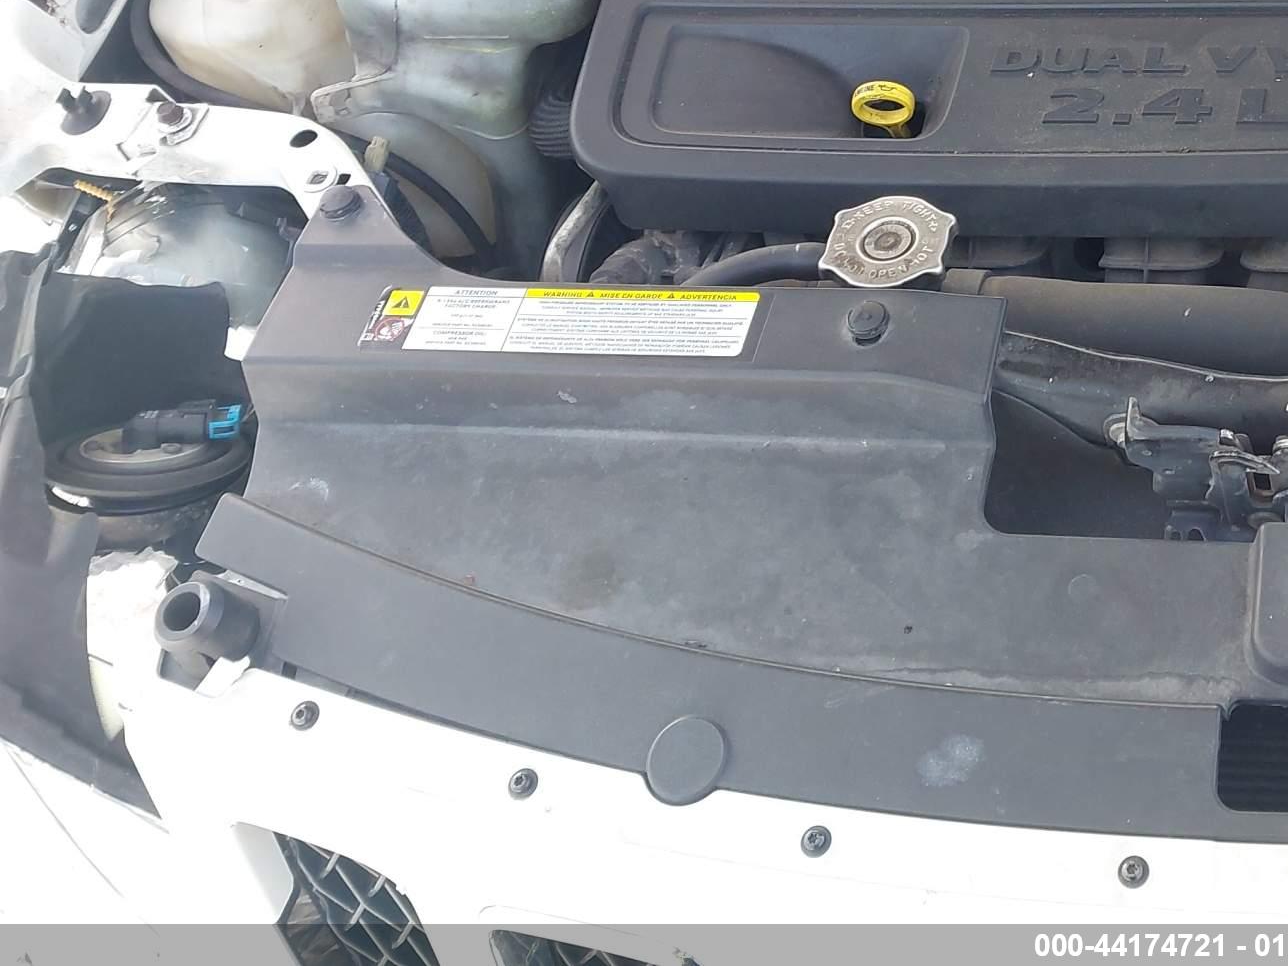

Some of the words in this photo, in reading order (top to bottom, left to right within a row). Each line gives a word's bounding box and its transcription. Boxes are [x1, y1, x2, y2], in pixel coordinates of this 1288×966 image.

[990, 46, 1187, 75] DUAL
[869, 264, 908, 279] OPEN
[455, 289, 498, 297] ATTENTION
